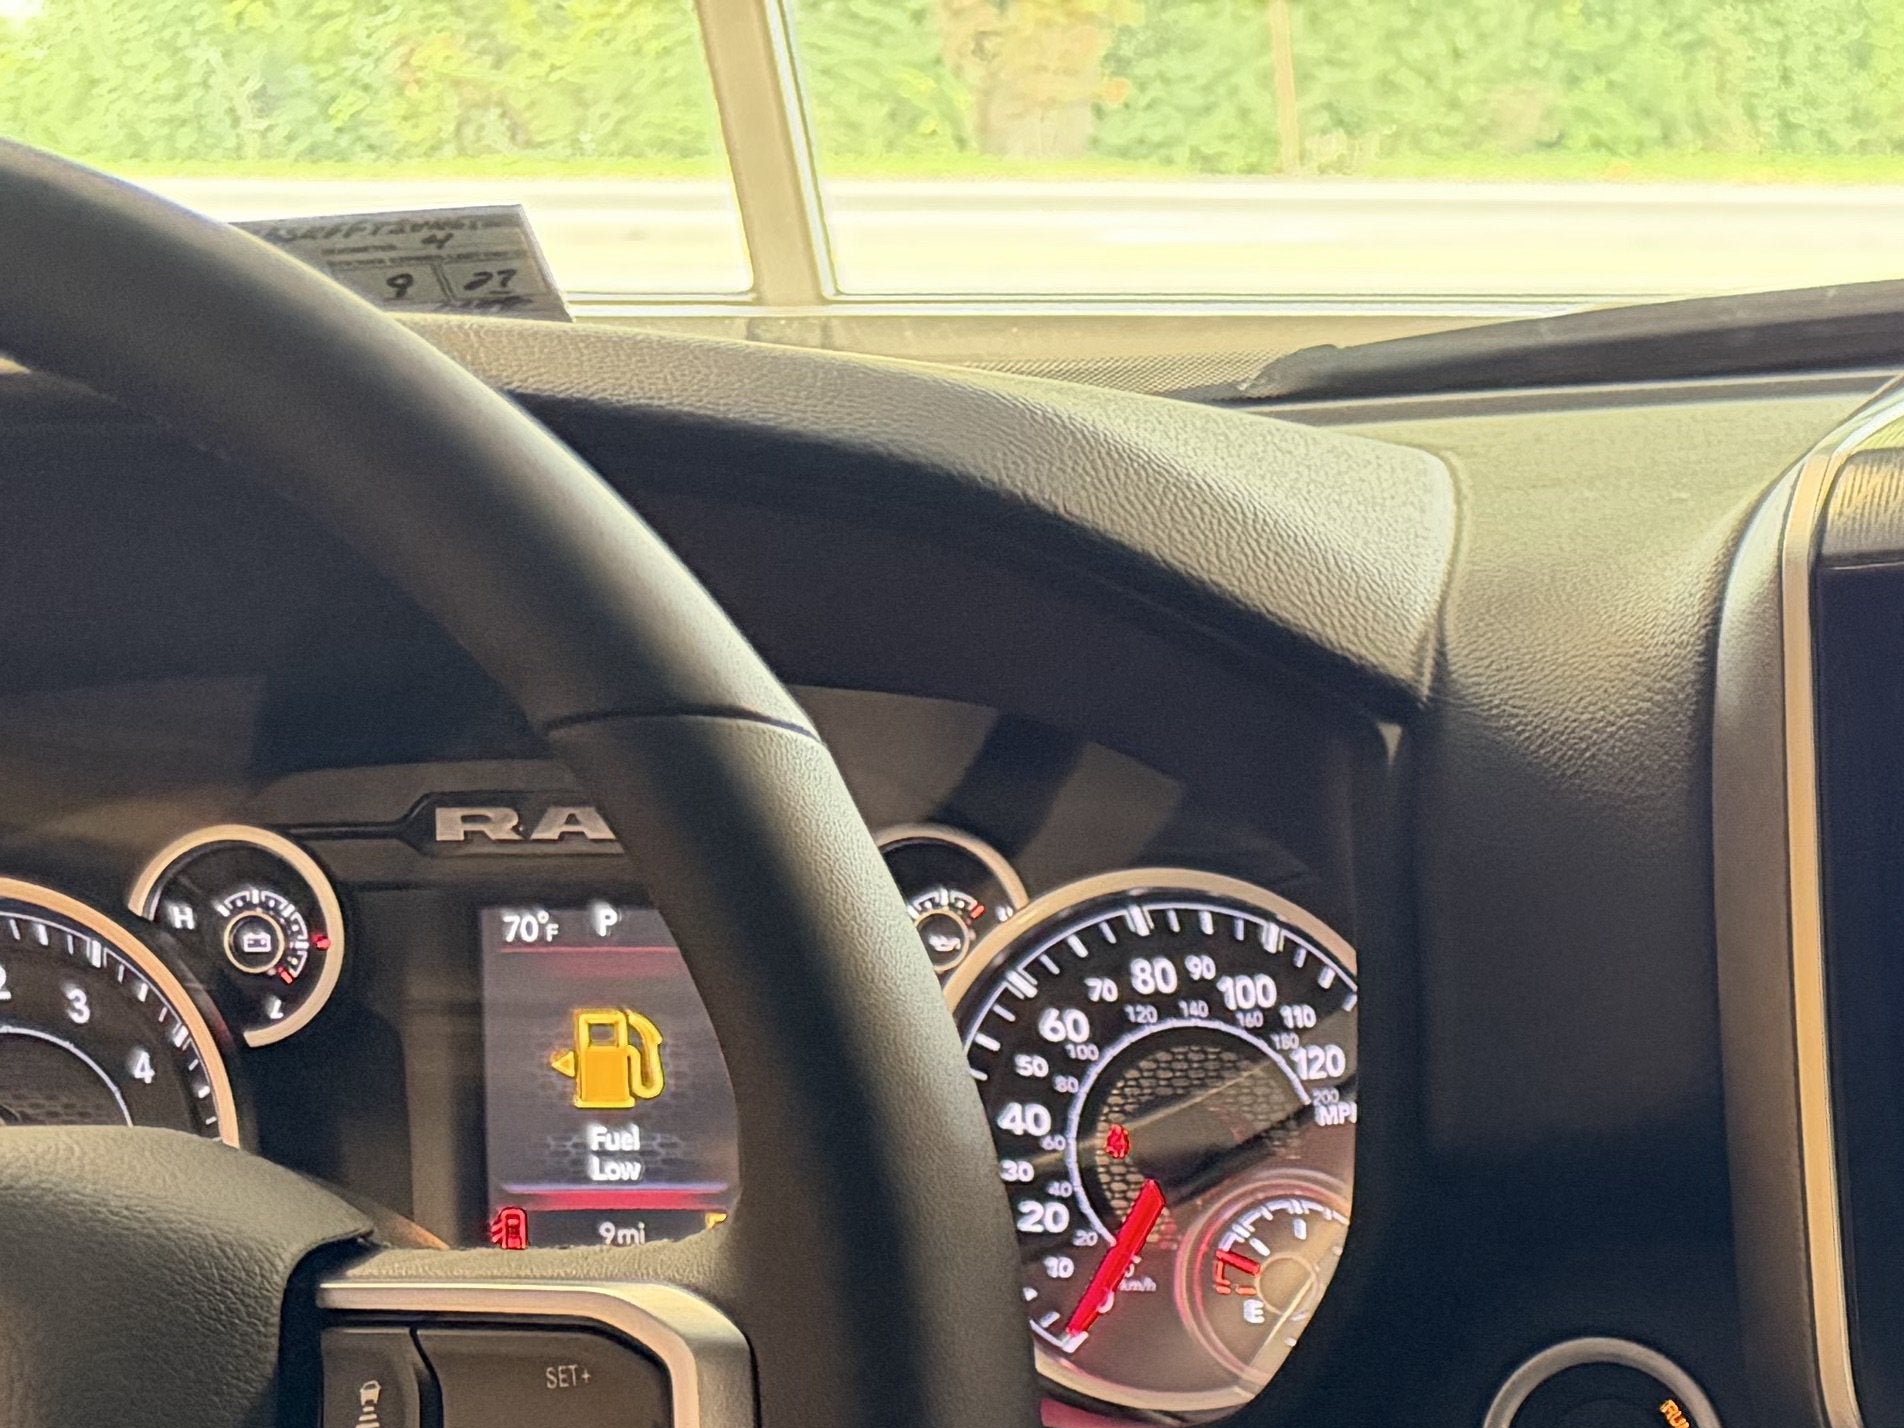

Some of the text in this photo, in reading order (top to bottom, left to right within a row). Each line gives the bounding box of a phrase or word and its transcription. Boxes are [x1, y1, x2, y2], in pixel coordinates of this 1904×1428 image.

[435, 806, 617, 841] RA
[172, 904, 195, 930] H
[596, 906, 618, 936] P
[1130, 959, 1177, 994] 80
[1184, 955, 1216, 980] 90
[1085, 977, 1118, 1002] 70
[1217, 975, 1277, 1010] 100
[66, 988, 90, 1024] 3
[1280, 1006, 1316, 1029] 110
[1038, 1008, 1090, 1044] 60
[131, 1049, 155, 1085] 4
[1015, 1054, 1049, 1077] 50
[1292, 1044, 1346, 1080] 120
[998, 1103, 1051, 1136] 40
[588, 1123, 640, 1151] Fuel
[590, 1155, 642, 1181] Low
[1000, 1161, 1034, 1182] 30
[1017, 1201, 1069, 1234] 20
[1044, 1256, 1074, 1279] 10
[1244, 1299, 1265, 1324] E
